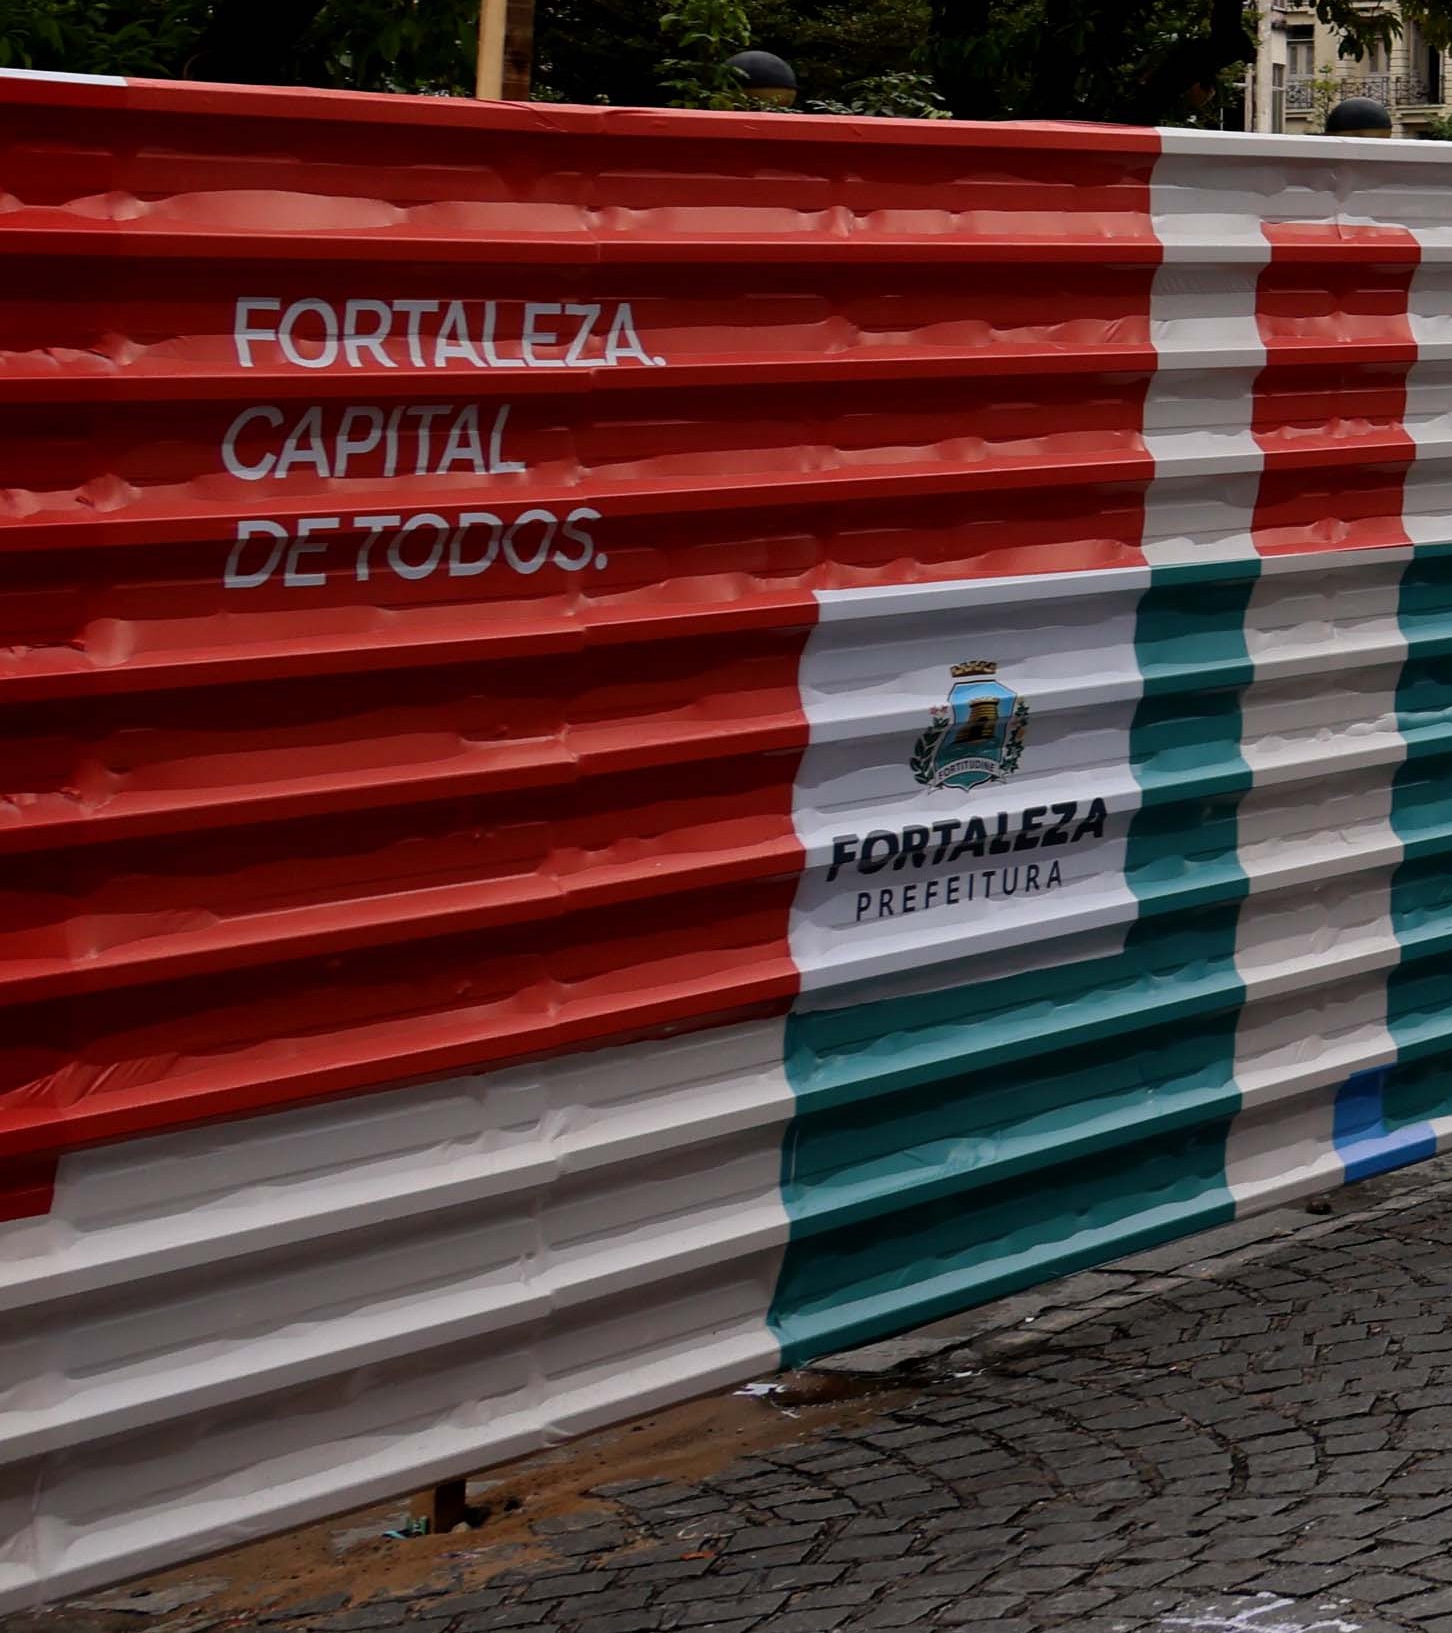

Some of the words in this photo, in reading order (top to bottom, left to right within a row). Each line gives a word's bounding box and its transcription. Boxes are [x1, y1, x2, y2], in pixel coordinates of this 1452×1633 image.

[233, 297, 667, 369] FORTALEZA.
[222, 403, 527, 481] CAPITAL
[223, 518, 339, 589] DE
[347, 506, 607, 582] TODOS.
[825, 797, 1108, 882] FORTALEZA
[856, 860, 1064, 922] PREFEITURA
